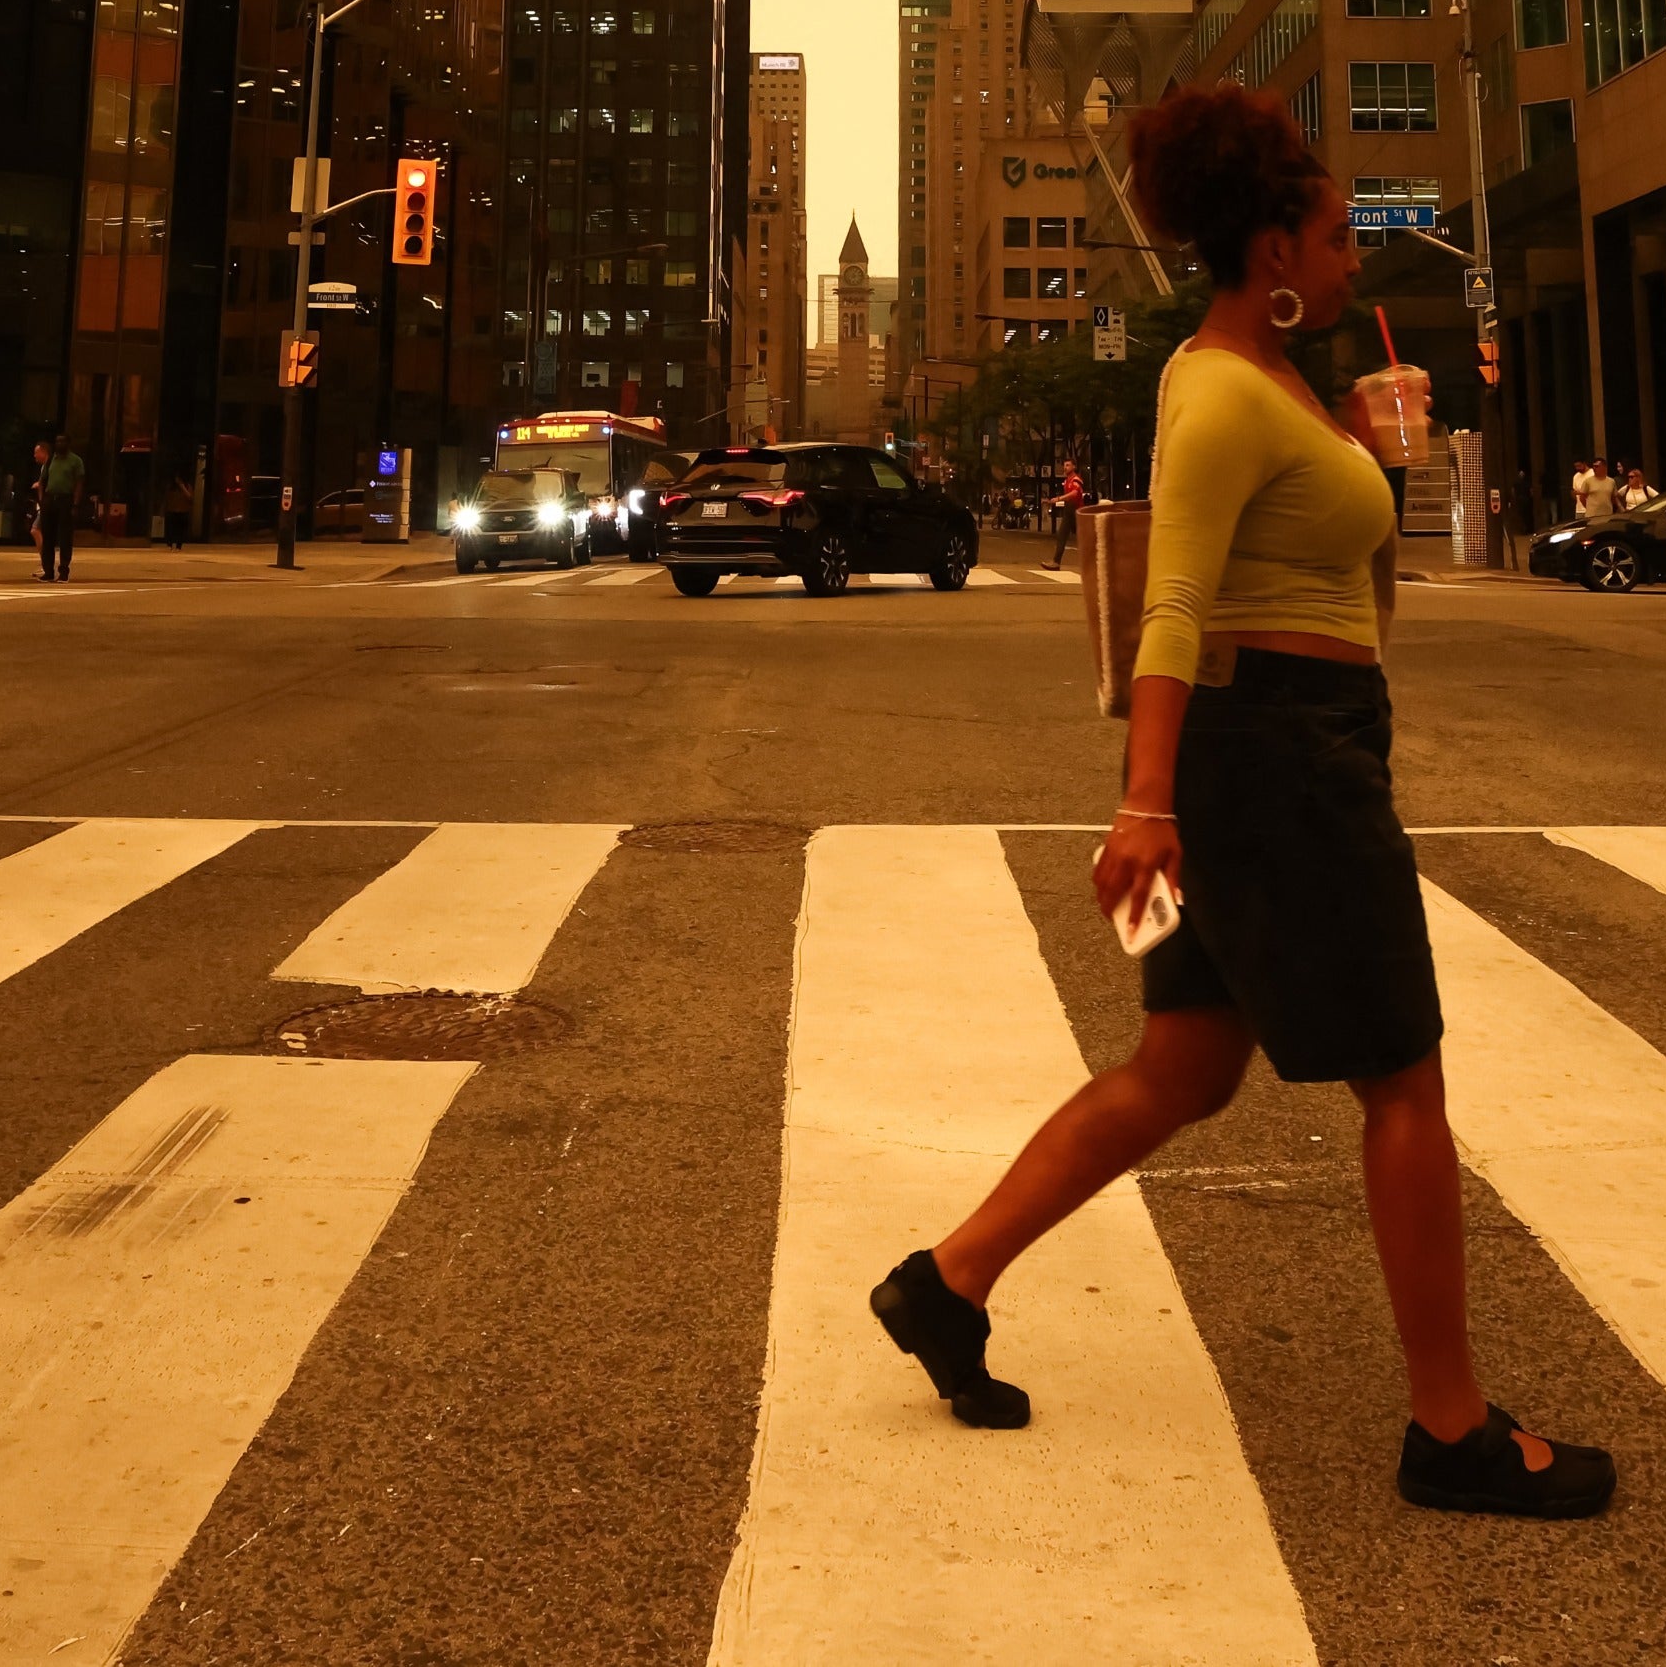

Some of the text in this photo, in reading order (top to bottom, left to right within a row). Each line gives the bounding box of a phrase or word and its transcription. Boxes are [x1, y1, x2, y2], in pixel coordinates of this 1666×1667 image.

[1033, 163, 1078, 180] Gree
[1394, 208, 1403, 217] St
[1406, 209, 1418, 223] W
[316, 293, 335, 302] Front
